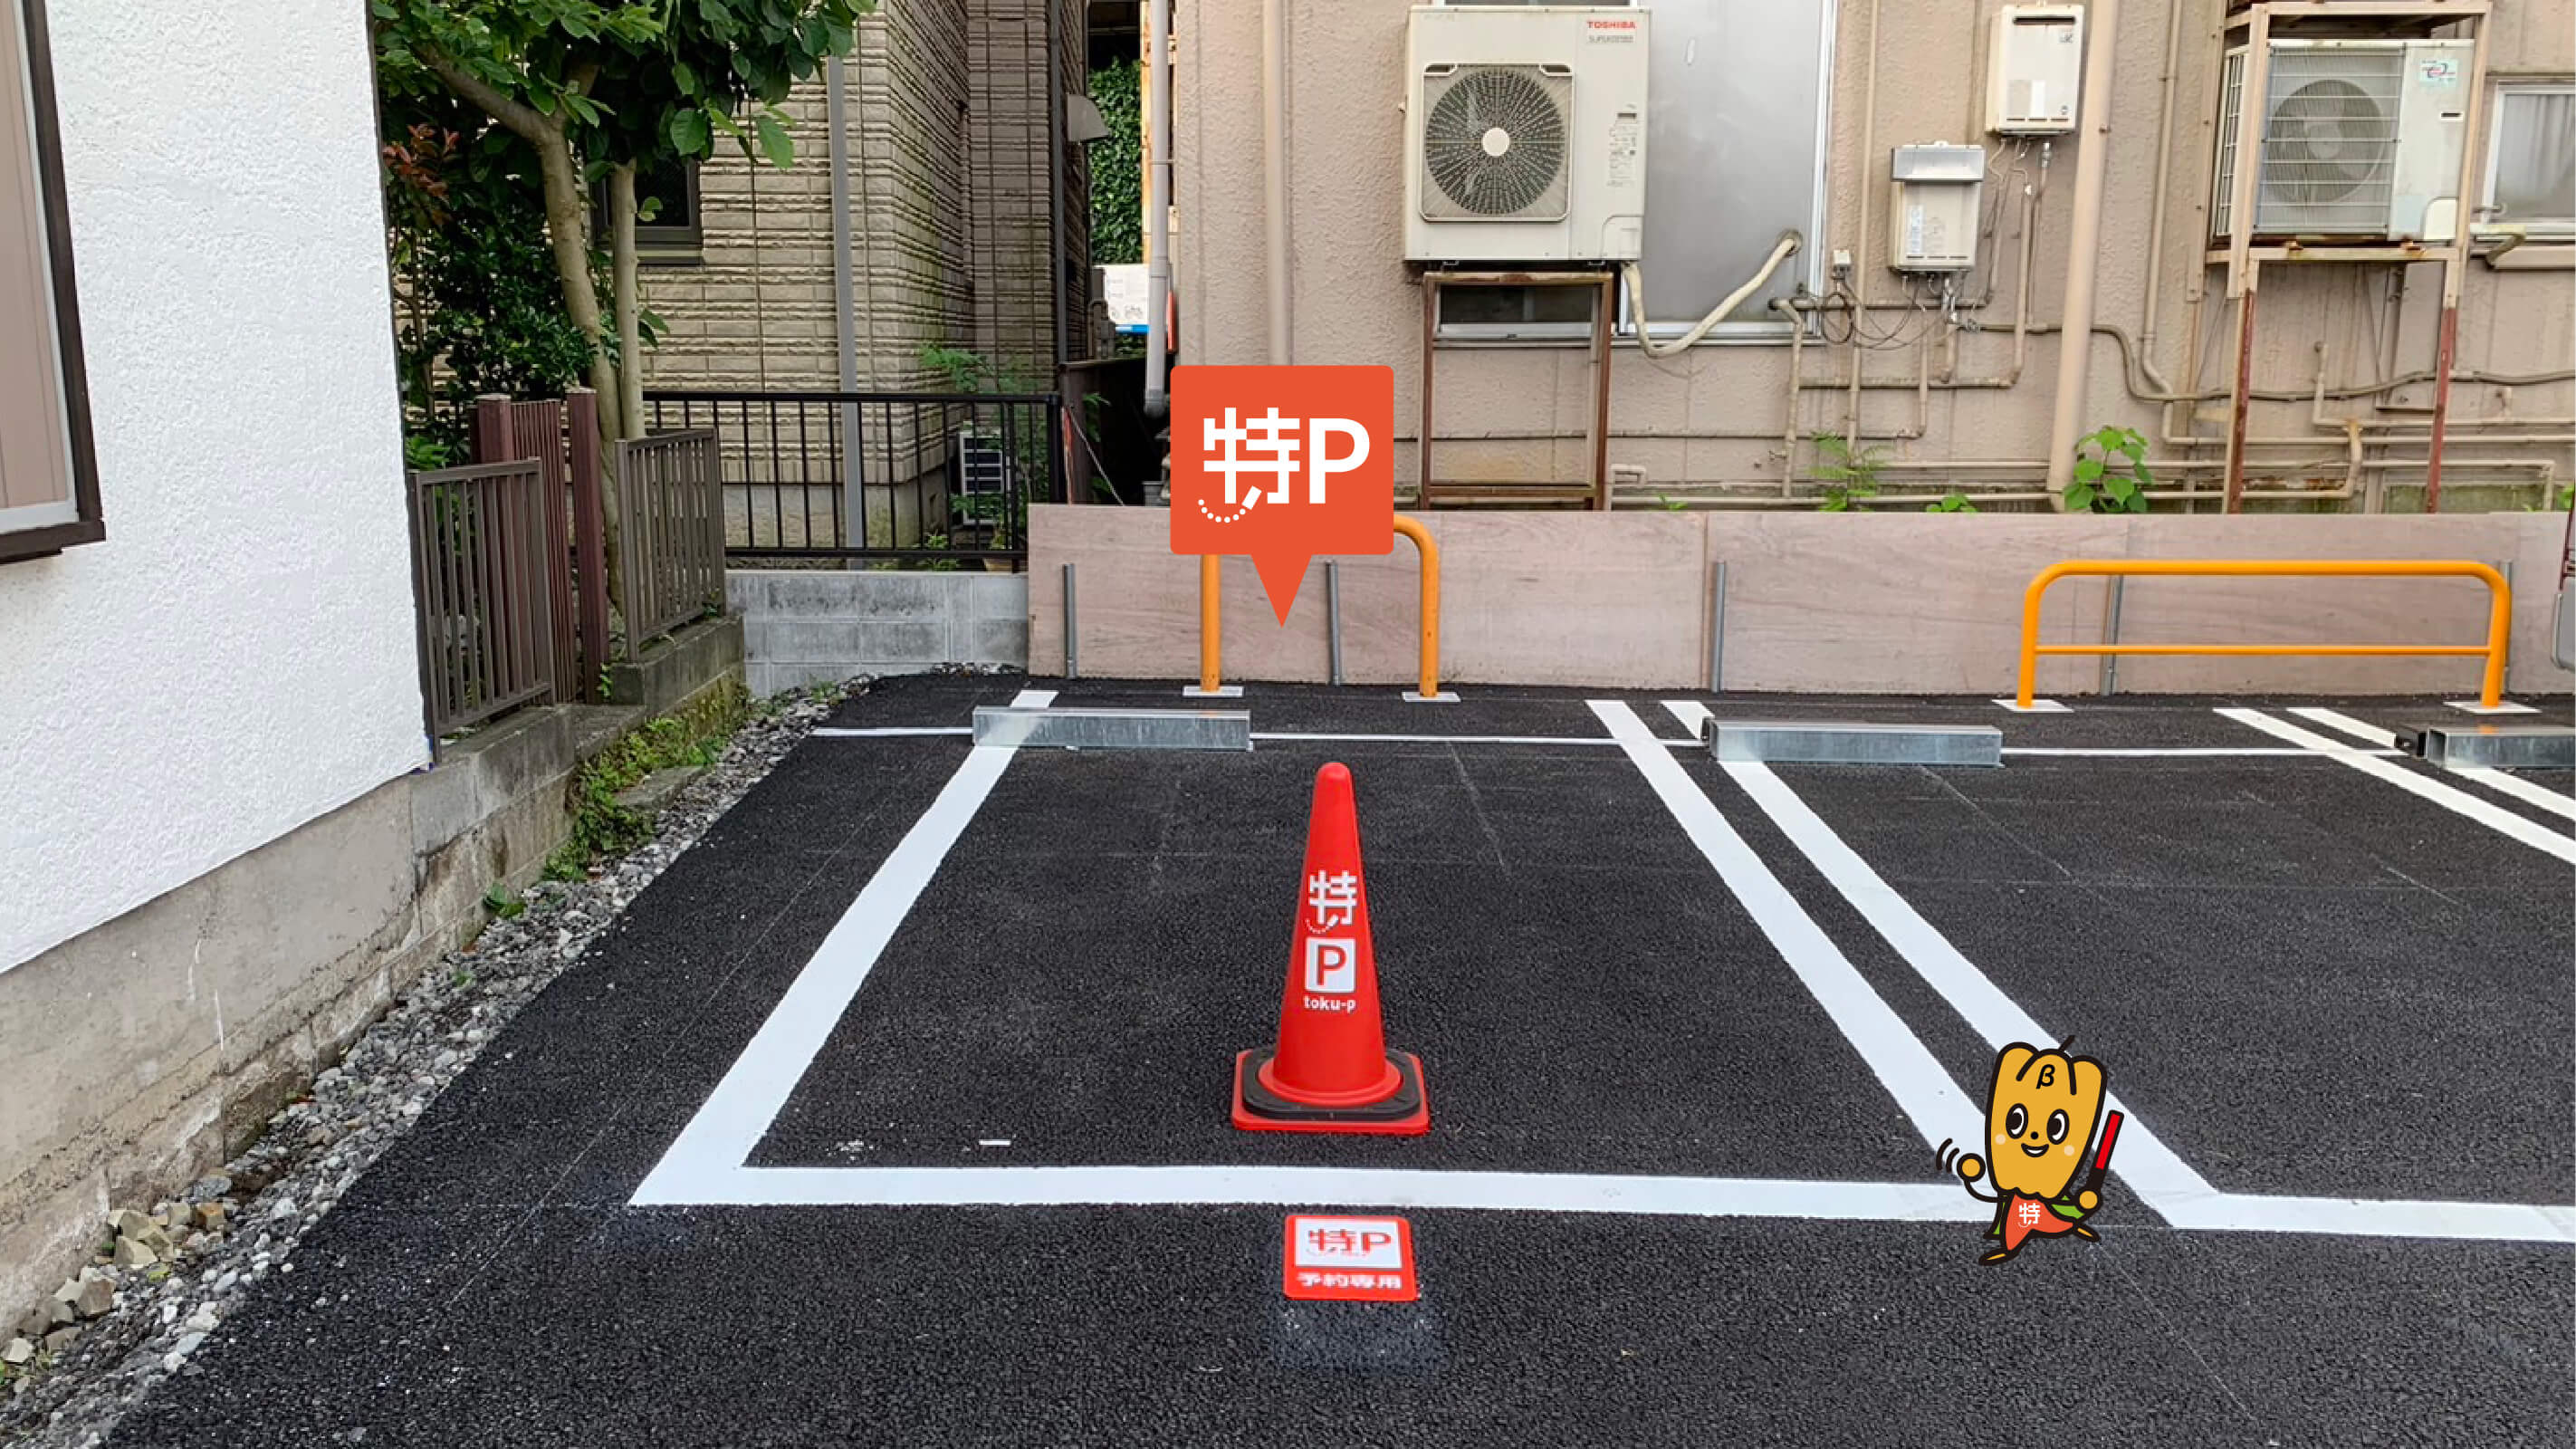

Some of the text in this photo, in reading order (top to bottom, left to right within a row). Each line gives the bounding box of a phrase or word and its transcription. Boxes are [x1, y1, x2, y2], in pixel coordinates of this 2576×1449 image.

[1586, 21, 1636, 29] TOSHIBA
[1307, 869, 1358, 927] 特
[1316, 944, 1347, 987] P
[1303, 994, 1356, 1012] toku-p
